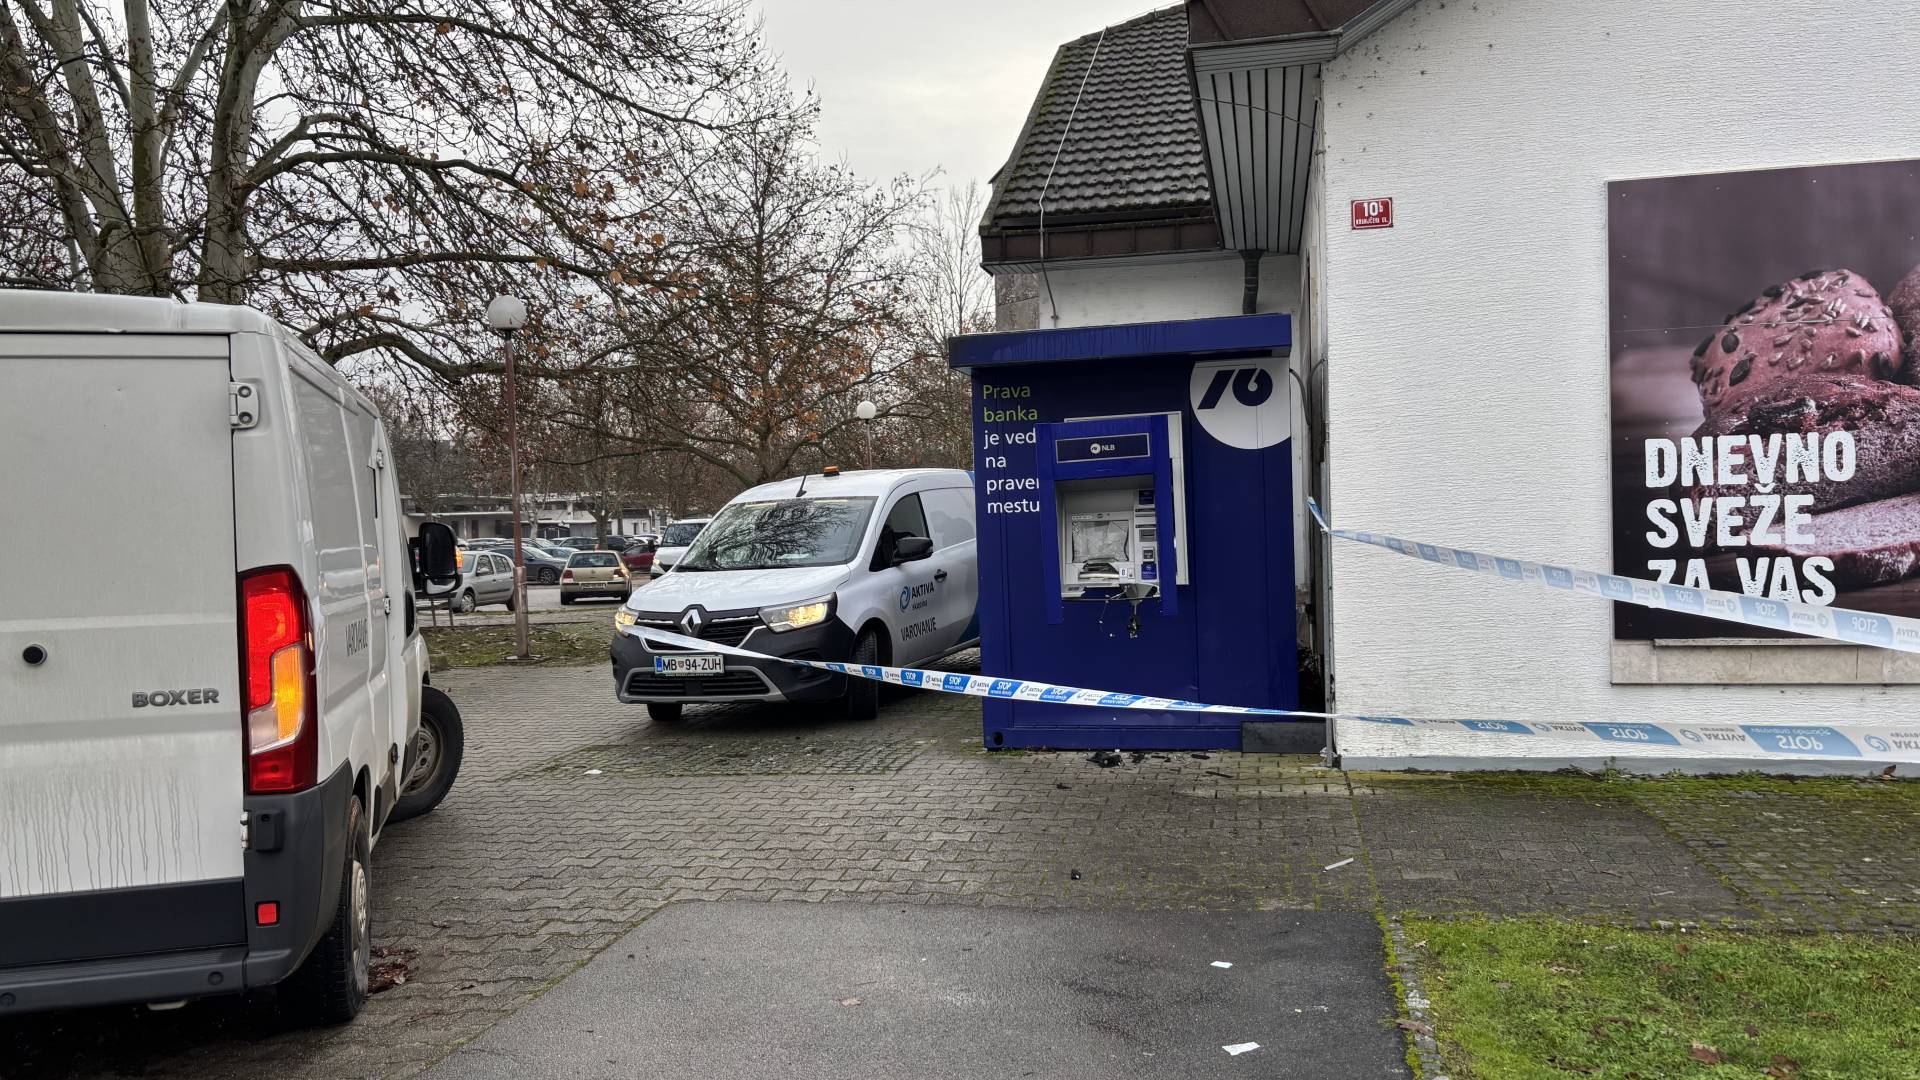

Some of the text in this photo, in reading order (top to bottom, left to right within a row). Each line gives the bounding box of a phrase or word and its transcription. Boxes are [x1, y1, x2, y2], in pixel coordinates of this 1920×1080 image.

[983, 384, 1031, 400] Prava
[984, 405, 1038, 422] banka
[984, 430, 1000, 450] je
[986, 456, 1007, 468] na
[1645, 431, 1857, 488] DNEVNO
[987, 499, 1040, 514] mestu
[1646, 483, 1816, 549] SVEŽE
[1647, 556, 1836, 606] ZA VAS
[912, 582, 934, 599] AKTIVA
[901, 617, 936, 641] VAROVANJE
[663, 658, 722, 671] MB 94-ZUH
[997, 682, 1012, 690] STOP
[132, 688, 219, 708] BOXER
